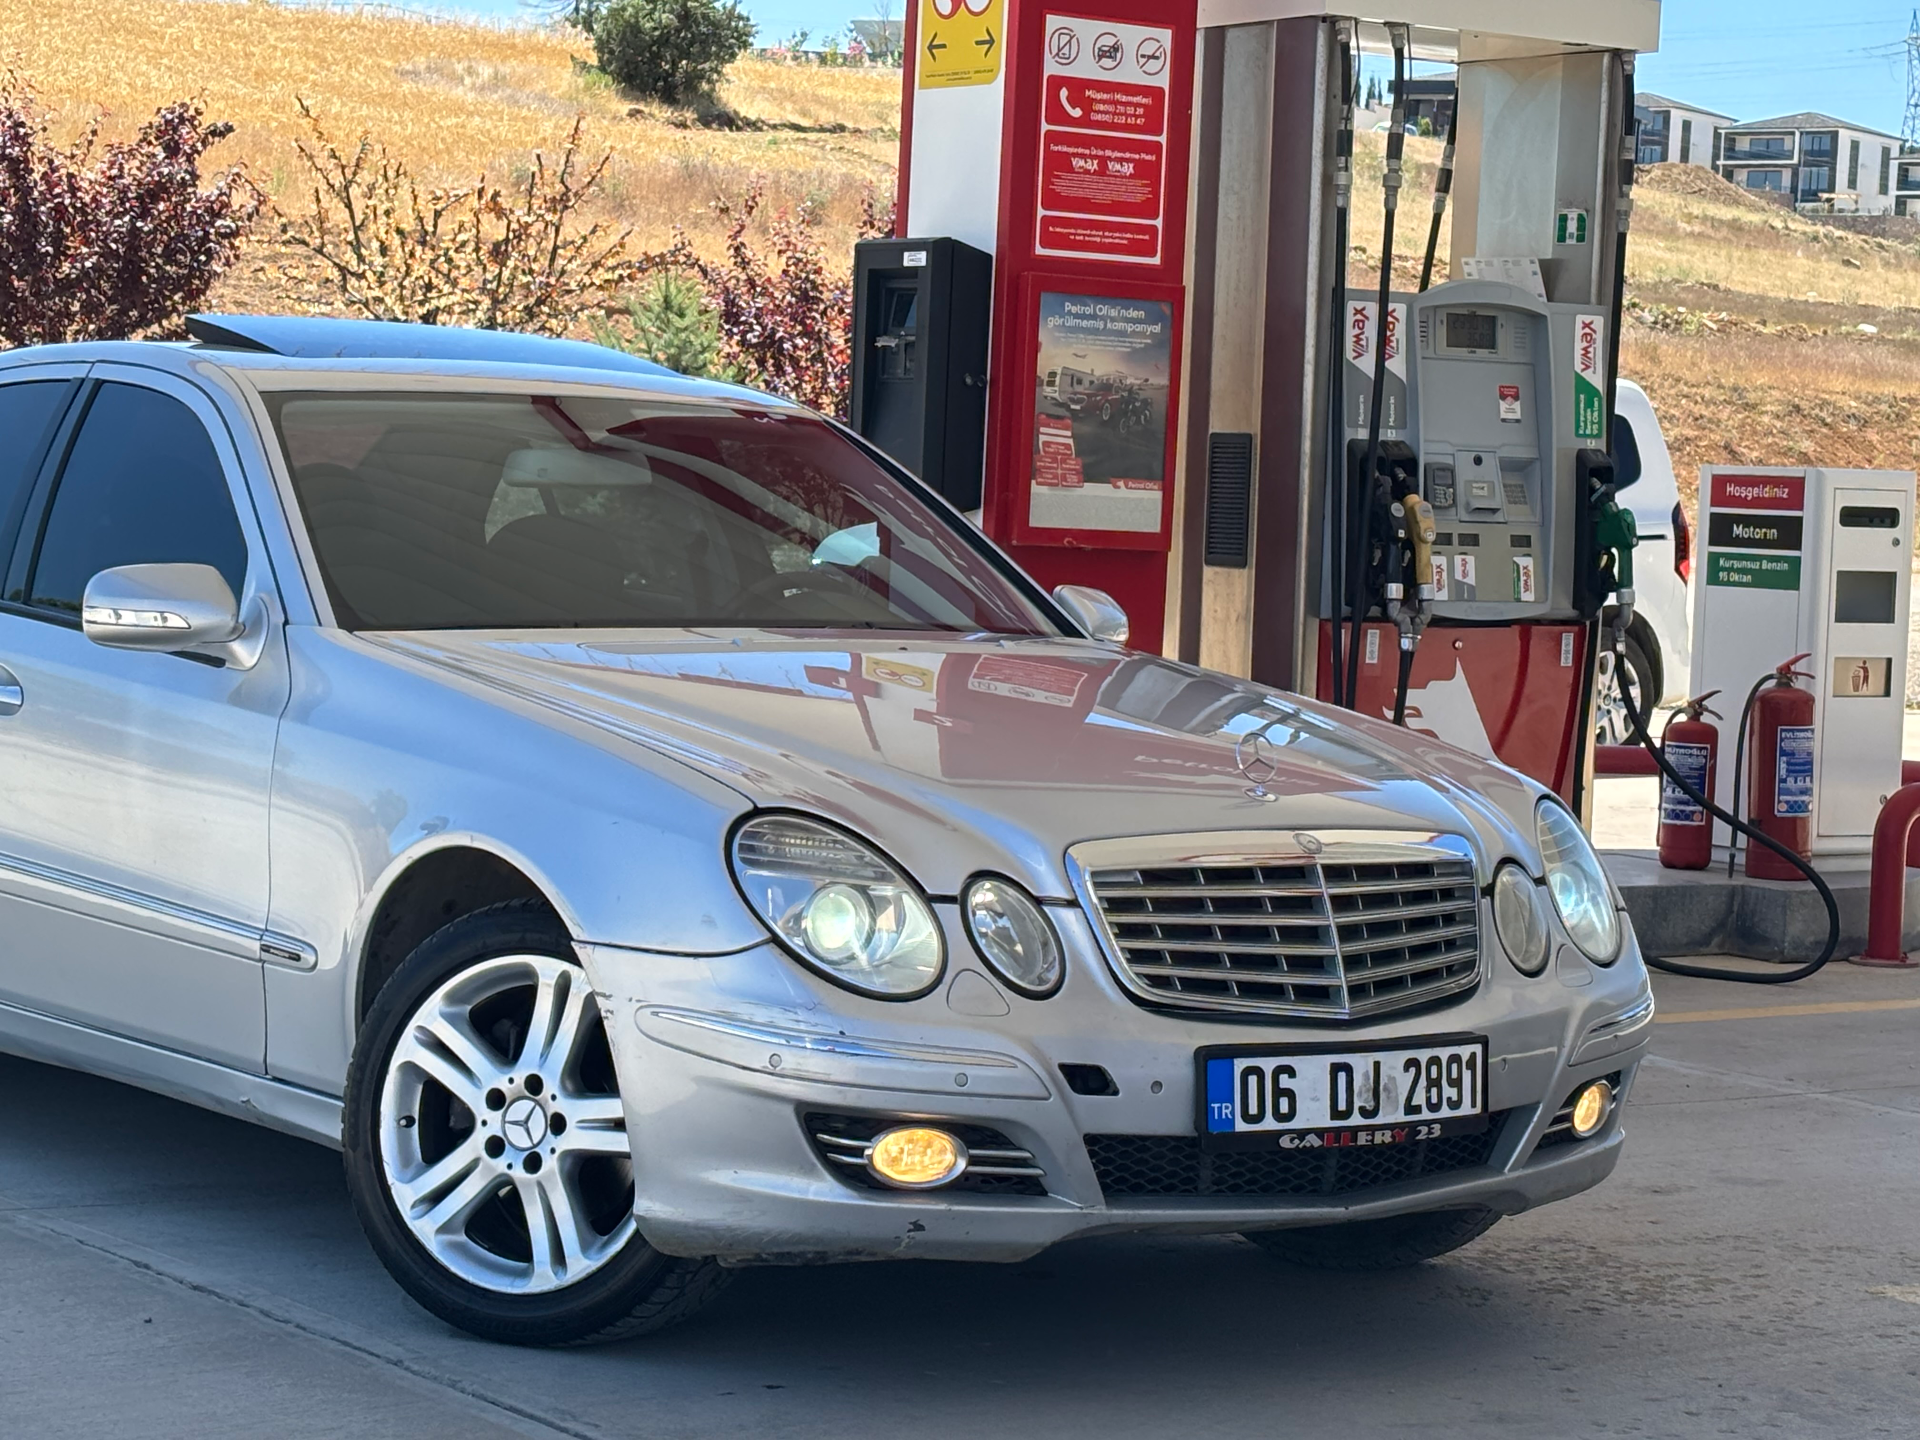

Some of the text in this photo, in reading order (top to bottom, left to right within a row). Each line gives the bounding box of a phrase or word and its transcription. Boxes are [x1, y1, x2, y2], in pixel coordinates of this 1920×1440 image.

[1064, 302, 1094, 315] Petrol
[1048, 316, 1104, 330] görülmemiş
[1726, 482, 1789, 500] Hoşgeldiniz
[1720, 557, 1788, 570] Kurşunsuz Benzin
[1718, 572, 1752, 582] 95 Oktan
[1240, 1052, 1478, 1124] 06 DJ 2891
[1211, 1103, 1232, 1120] TR
[1278, 1124, 1442, 1150] GALLERY 23
